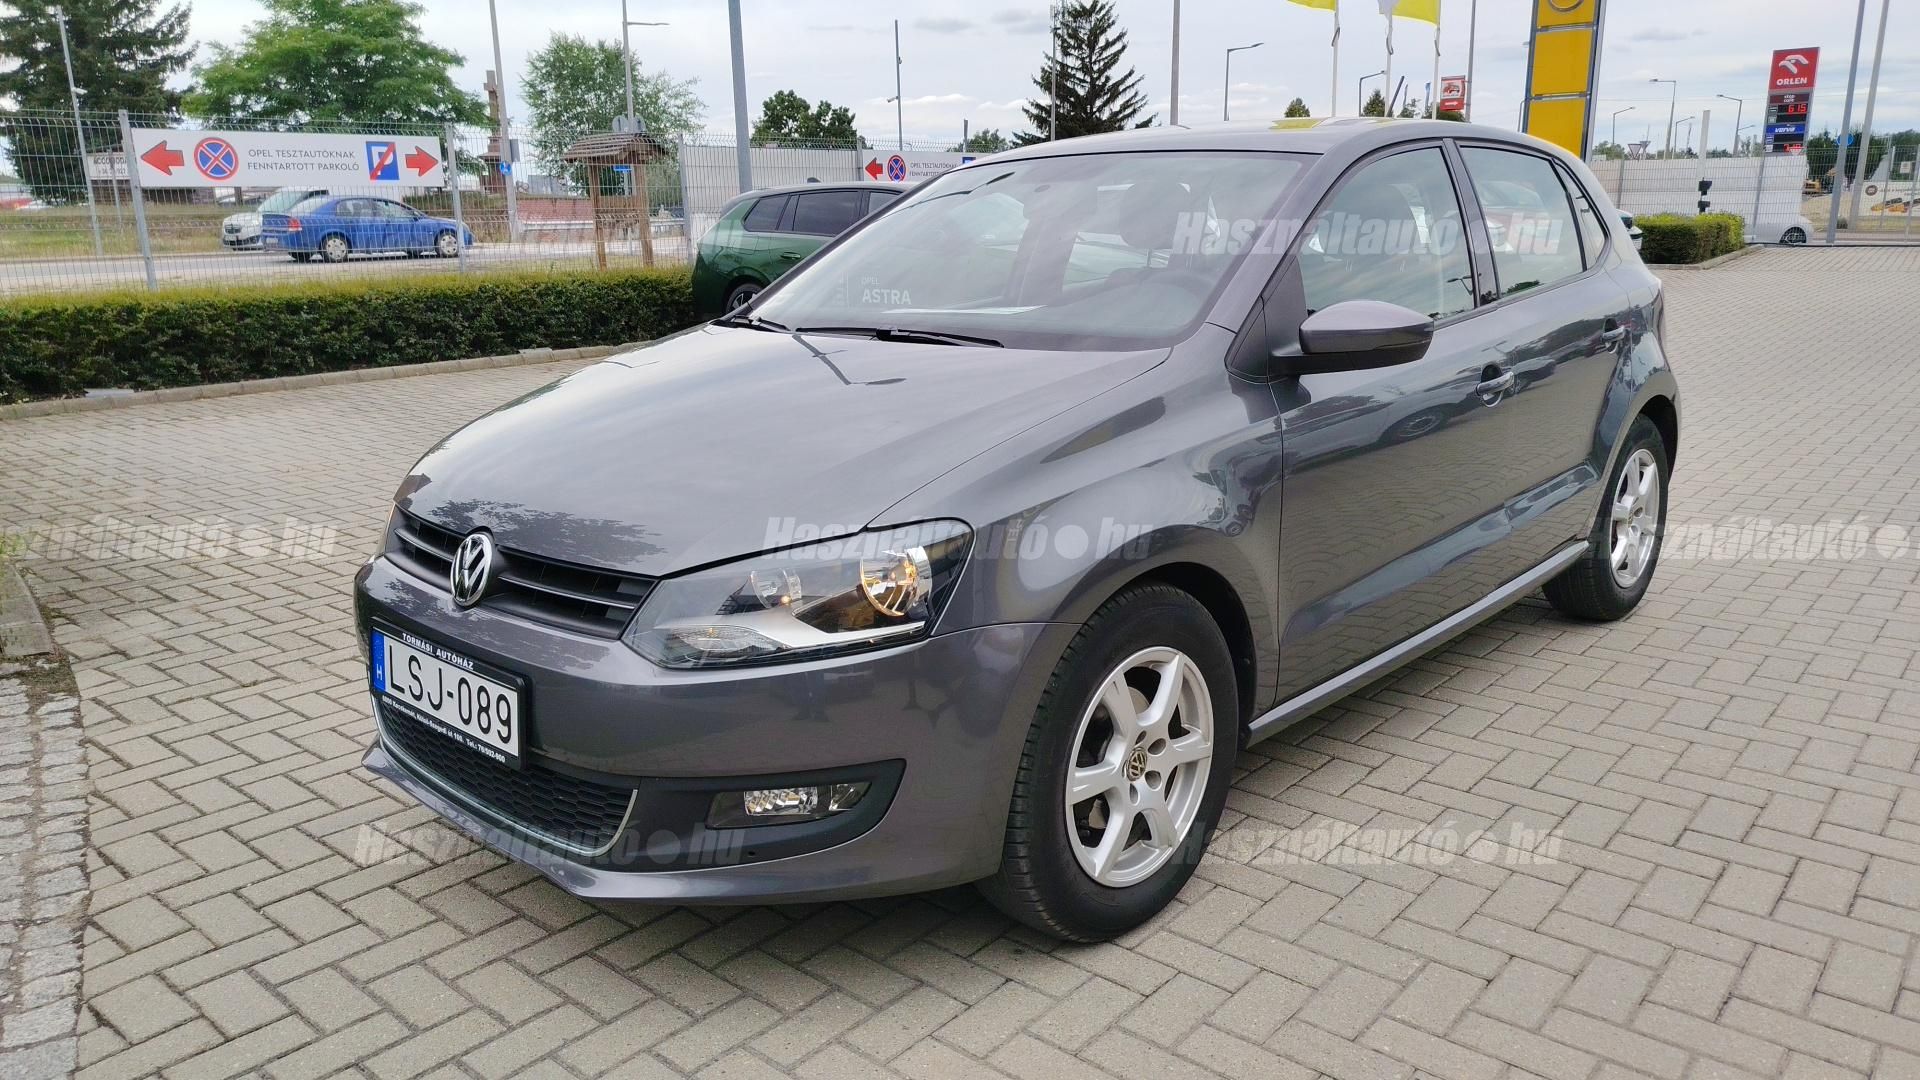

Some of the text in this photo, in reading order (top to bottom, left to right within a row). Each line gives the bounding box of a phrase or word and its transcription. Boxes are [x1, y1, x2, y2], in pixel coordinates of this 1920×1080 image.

[1776, 77, 1808, 86] ORLEN
[248, 148, 356, 159] OPEL TESZTAUTÓKNAK
[247, 160, 360, 172] FENNTARTOTT PARKOLÓ
[861, 288, 912, 305] ASTRA
[402, 632, 475, 672] TORMÁSI AUTÓHÁZ
[376, 663, 383, 682] H
[388, 644, 513, 745] LSJ-089
